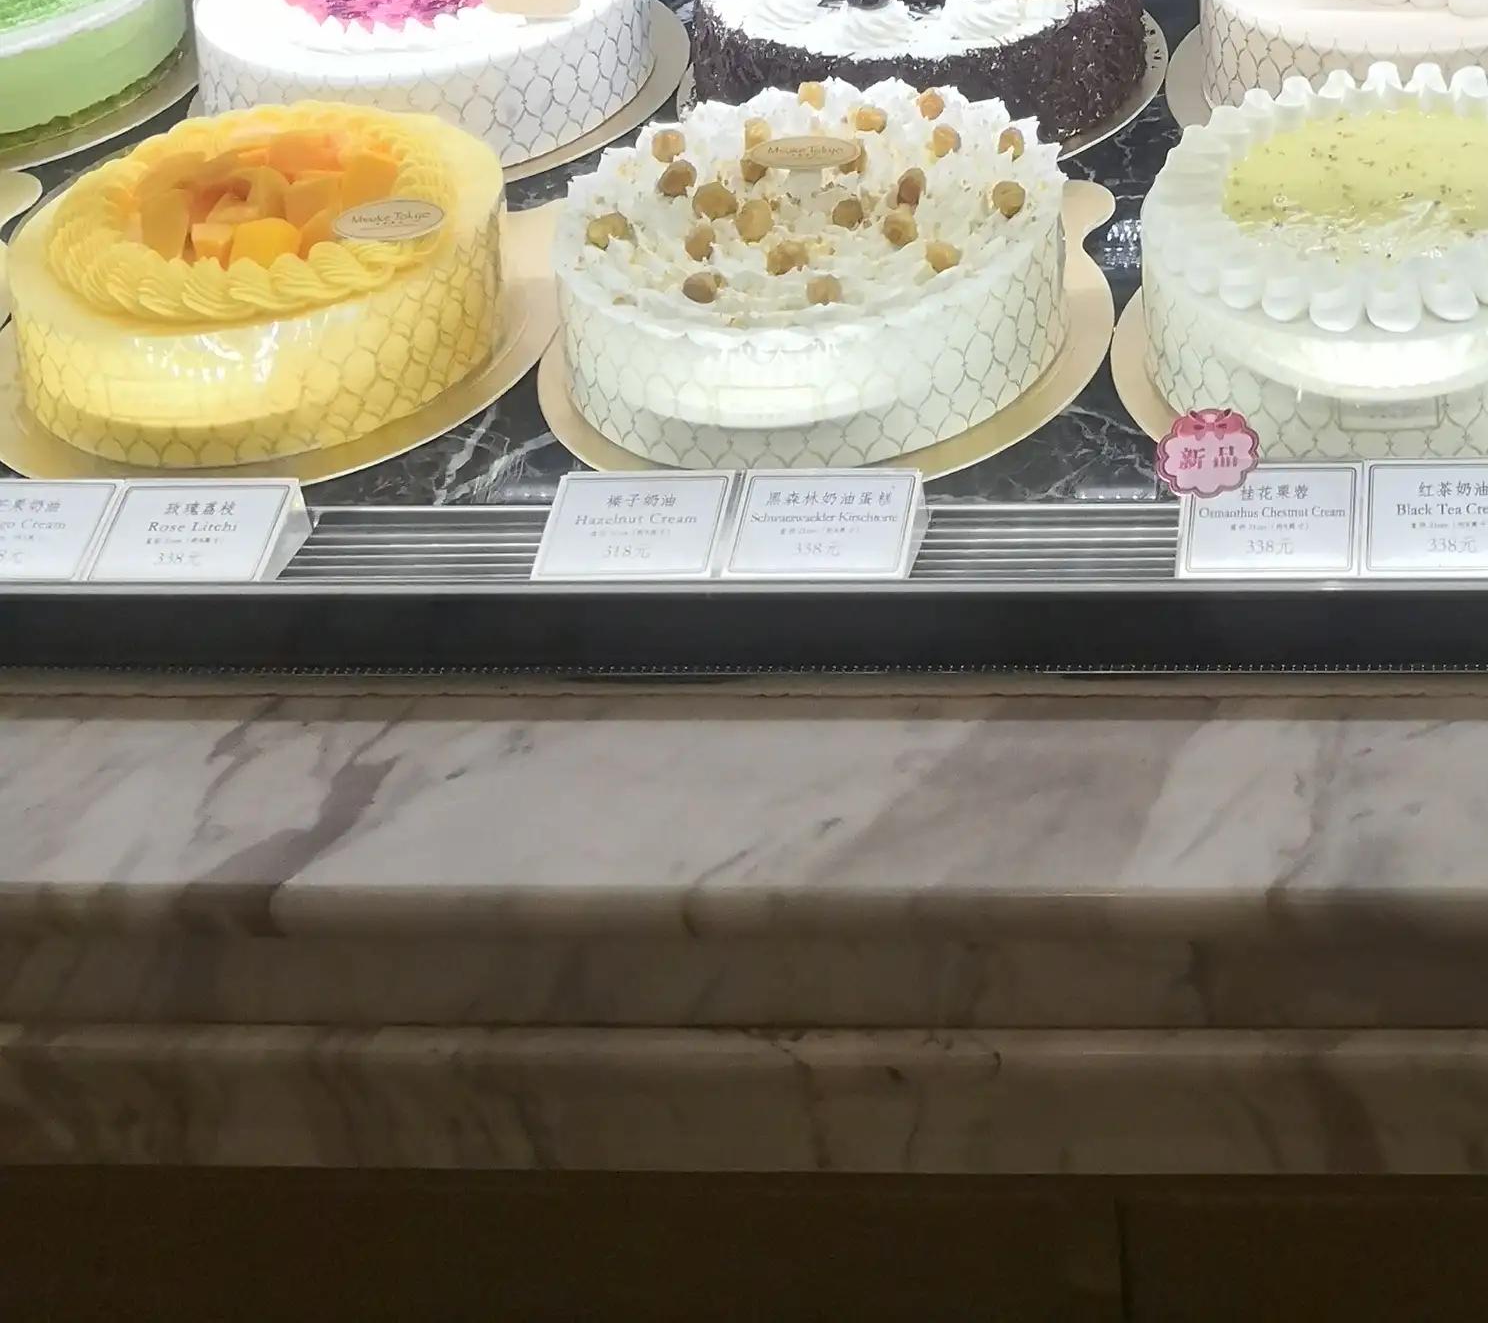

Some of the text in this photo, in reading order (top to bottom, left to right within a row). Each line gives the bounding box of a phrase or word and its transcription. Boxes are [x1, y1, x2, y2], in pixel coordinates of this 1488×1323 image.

[1179, 445, 1239, 471] 新品
[1418, 480, 1488, 498] 红茶奶油
[606, 493, 677, 508] 榛子奶油
[766, 491, 893, 507] 黑森林奶油蛋糕
[164, 499, 240, 516] 玫瑰荔枝
[1199, 505, 1346, 518] Osmanthus Chestnut Cream
[1396, 503, 1432, 516] Black
[1436, 503, 1463, 516] Tea
[20, 519, 66, 531] Cream
[147, 519, 238, 532] Rose Litchi
[574, 512, 697, 526] Hazelnut Cream
[1246, 538, 1294, 555] 338元
[1427, 536, 1477, 553] 338元
